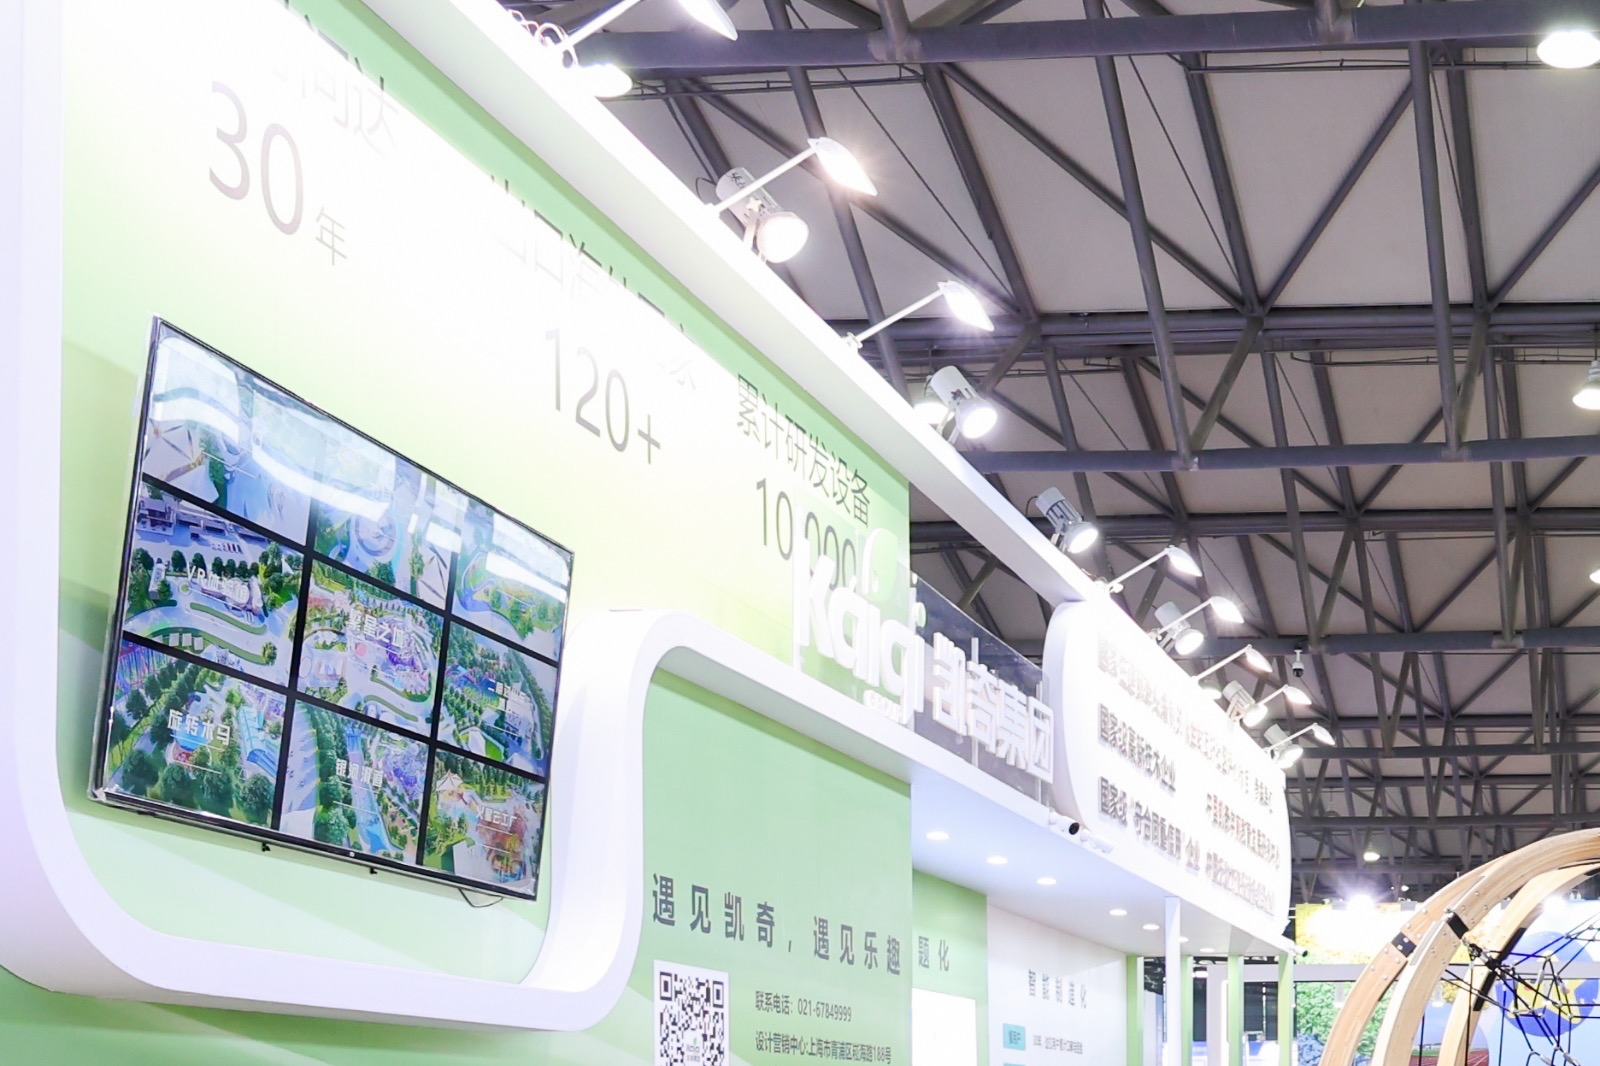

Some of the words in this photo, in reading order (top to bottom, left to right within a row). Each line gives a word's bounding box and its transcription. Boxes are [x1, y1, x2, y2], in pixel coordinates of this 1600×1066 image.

[209, 80, 304, 235] 30
[314, 207, 347, 266] 年
[545, 327, 661, 465] 120+
[737, 373, 871, 528] 累计研发设备
[167, 708, 231, 746] 旋转木马
[932, 632, 1054, 783] 凯奇集团
